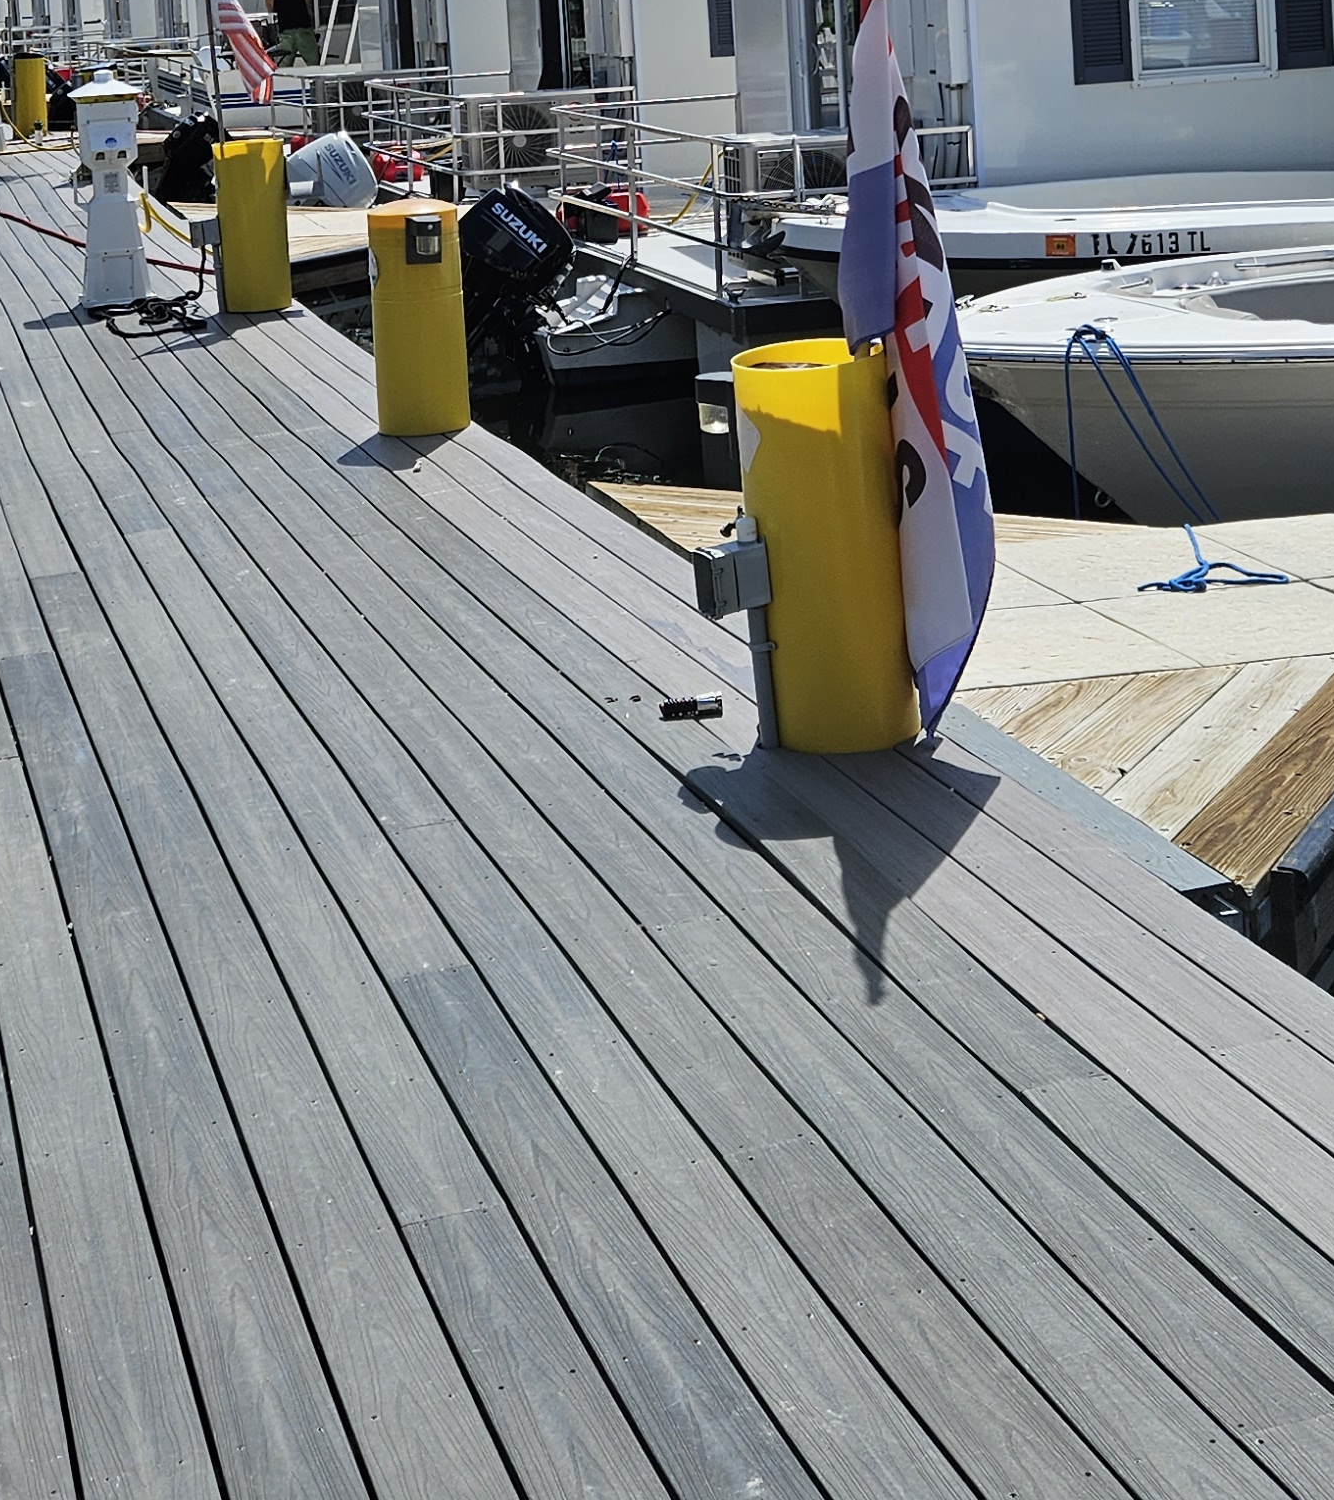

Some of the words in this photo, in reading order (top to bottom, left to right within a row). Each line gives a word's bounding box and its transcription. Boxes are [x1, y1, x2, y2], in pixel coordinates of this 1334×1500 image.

[324, 143, 357, 185] SUZUKI
[491, 202, 548, 254] SUZUKI
[1187, 230, 1211, 252] TL
